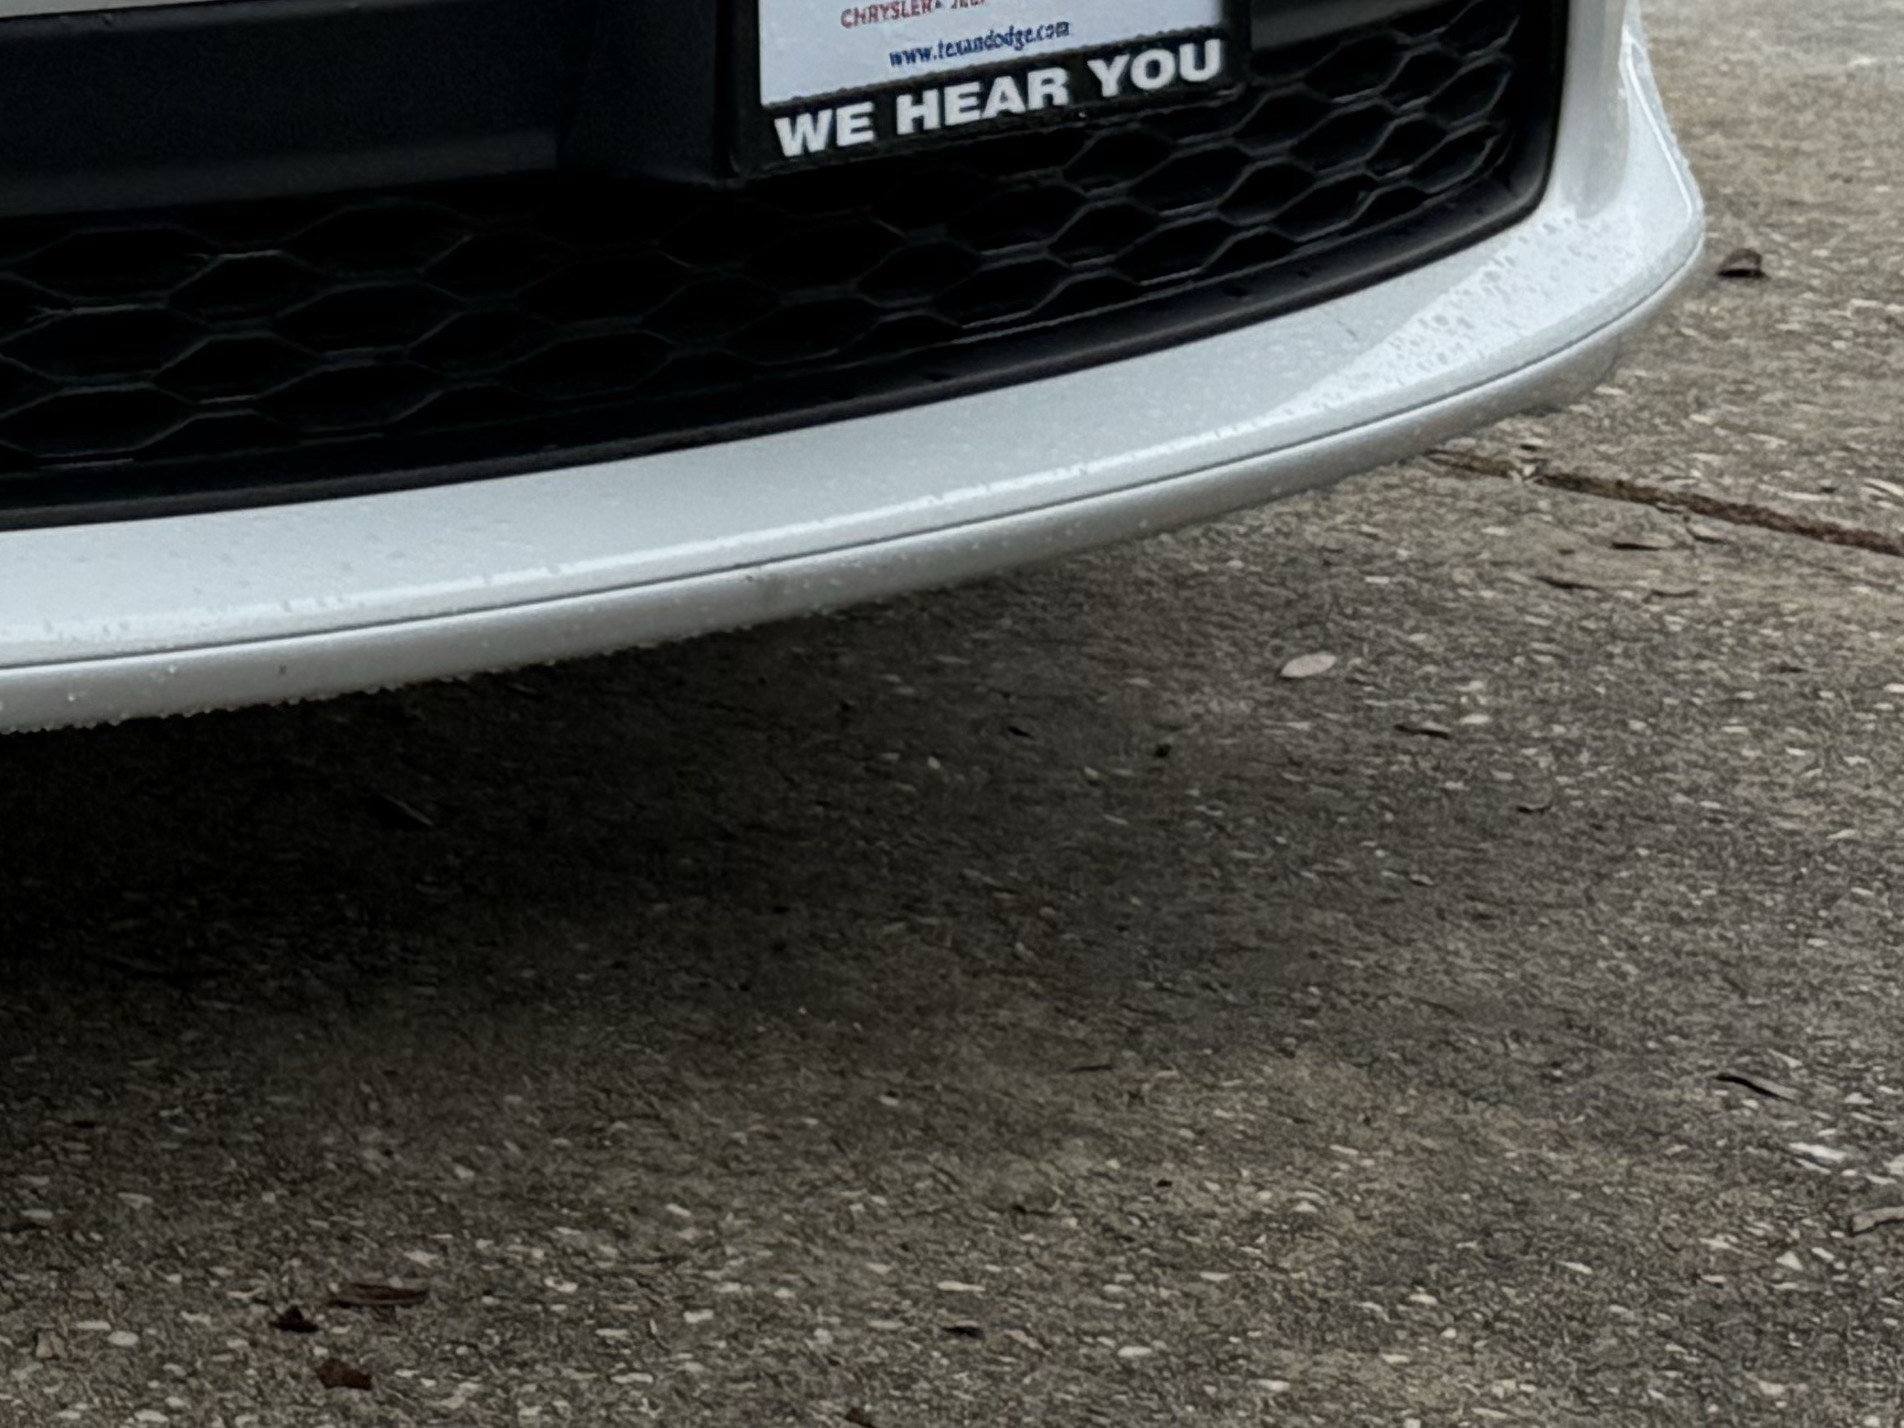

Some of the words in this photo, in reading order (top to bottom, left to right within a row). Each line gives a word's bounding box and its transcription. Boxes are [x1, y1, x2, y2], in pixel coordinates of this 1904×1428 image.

[889, 20, 1071, 67] www.texandodge.com
[773, 101, 876, 158] WE
[896, 66, 1070, 136] HEAR
[1087, 38, 1223, 98] YOU
